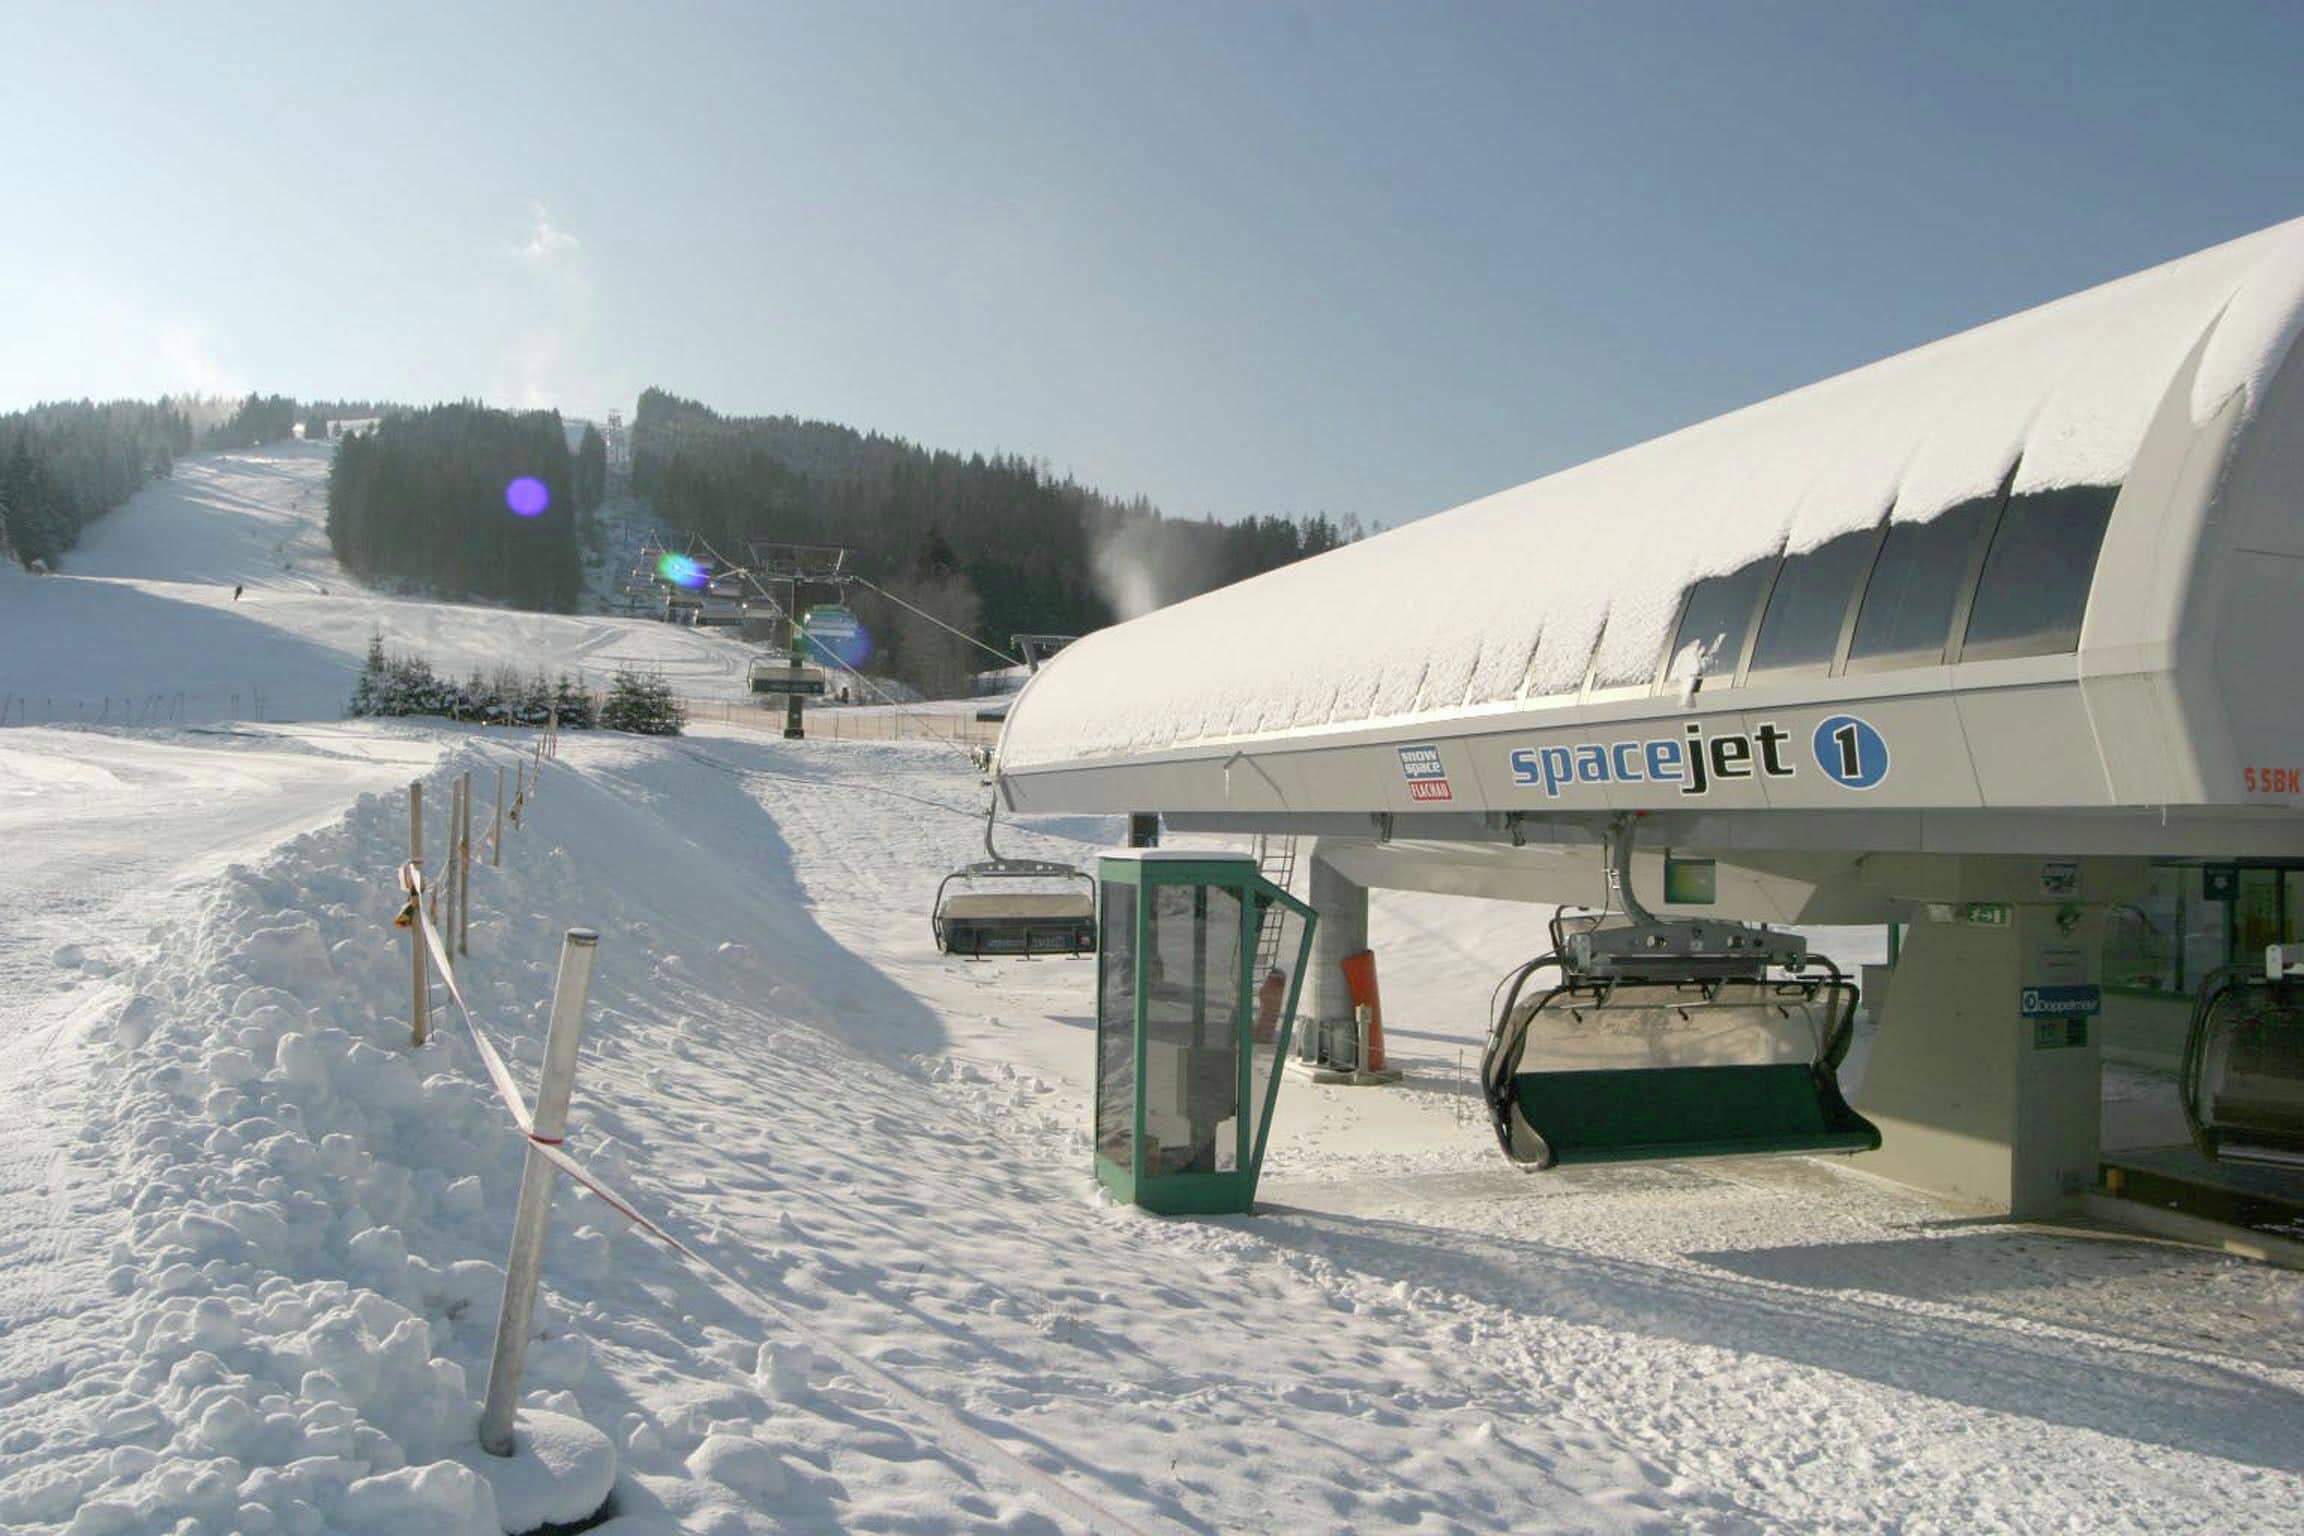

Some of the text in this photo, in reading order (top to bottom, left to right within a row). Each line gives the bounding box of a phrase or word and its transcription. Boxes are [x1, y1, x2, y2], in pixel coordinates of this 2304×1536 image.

[1401, 751, 1438, 763] snow
[1511, 723, 1862, 797] spacejet 1
[1404, 762, 1441, 777] space
[1410, 782, 1450, 799] FLACHAU
